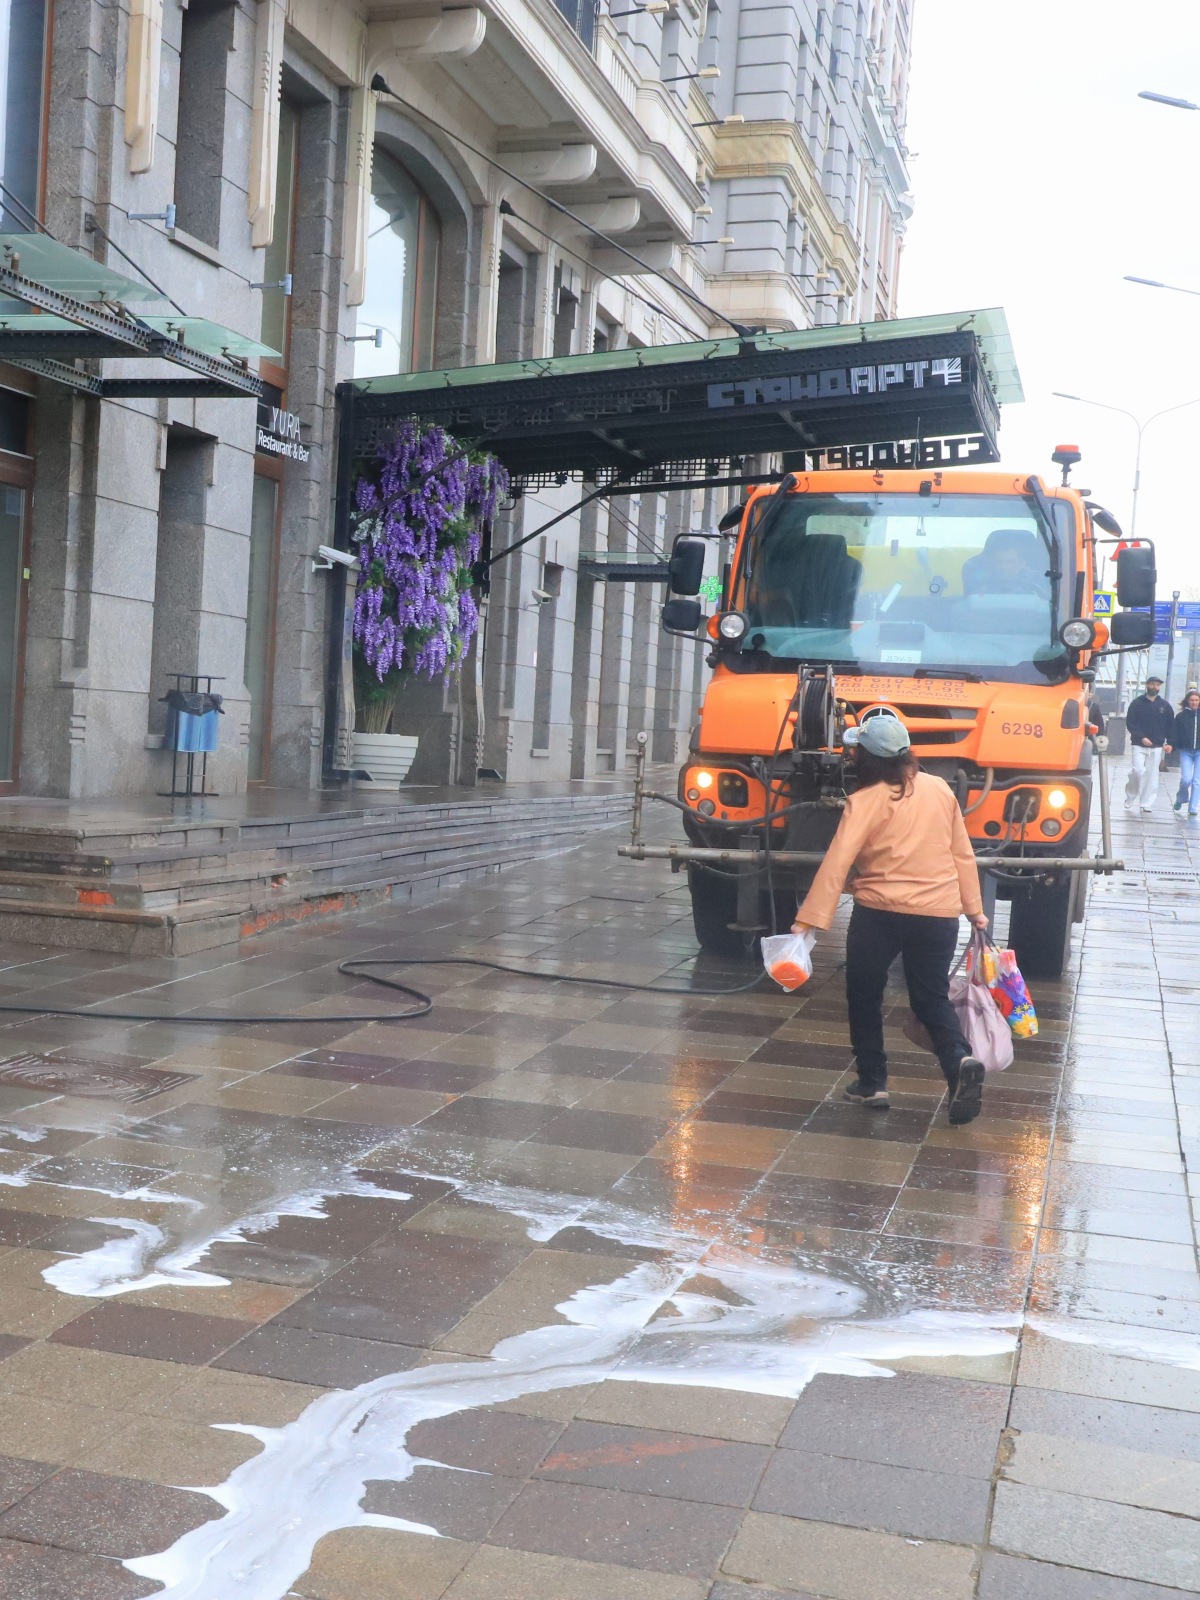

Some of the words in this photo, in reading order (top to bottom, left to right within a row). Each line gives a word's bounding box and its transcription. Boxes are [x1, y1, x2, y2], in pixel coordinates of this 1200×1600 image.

[272, 406, 300, 441] YURA
[257, 430, 292, 457] Restaurant
[293, 444, 298, 459] &
[299, 445, 310, 462] Bar
[1002, 722, 1043, 738] 6298
